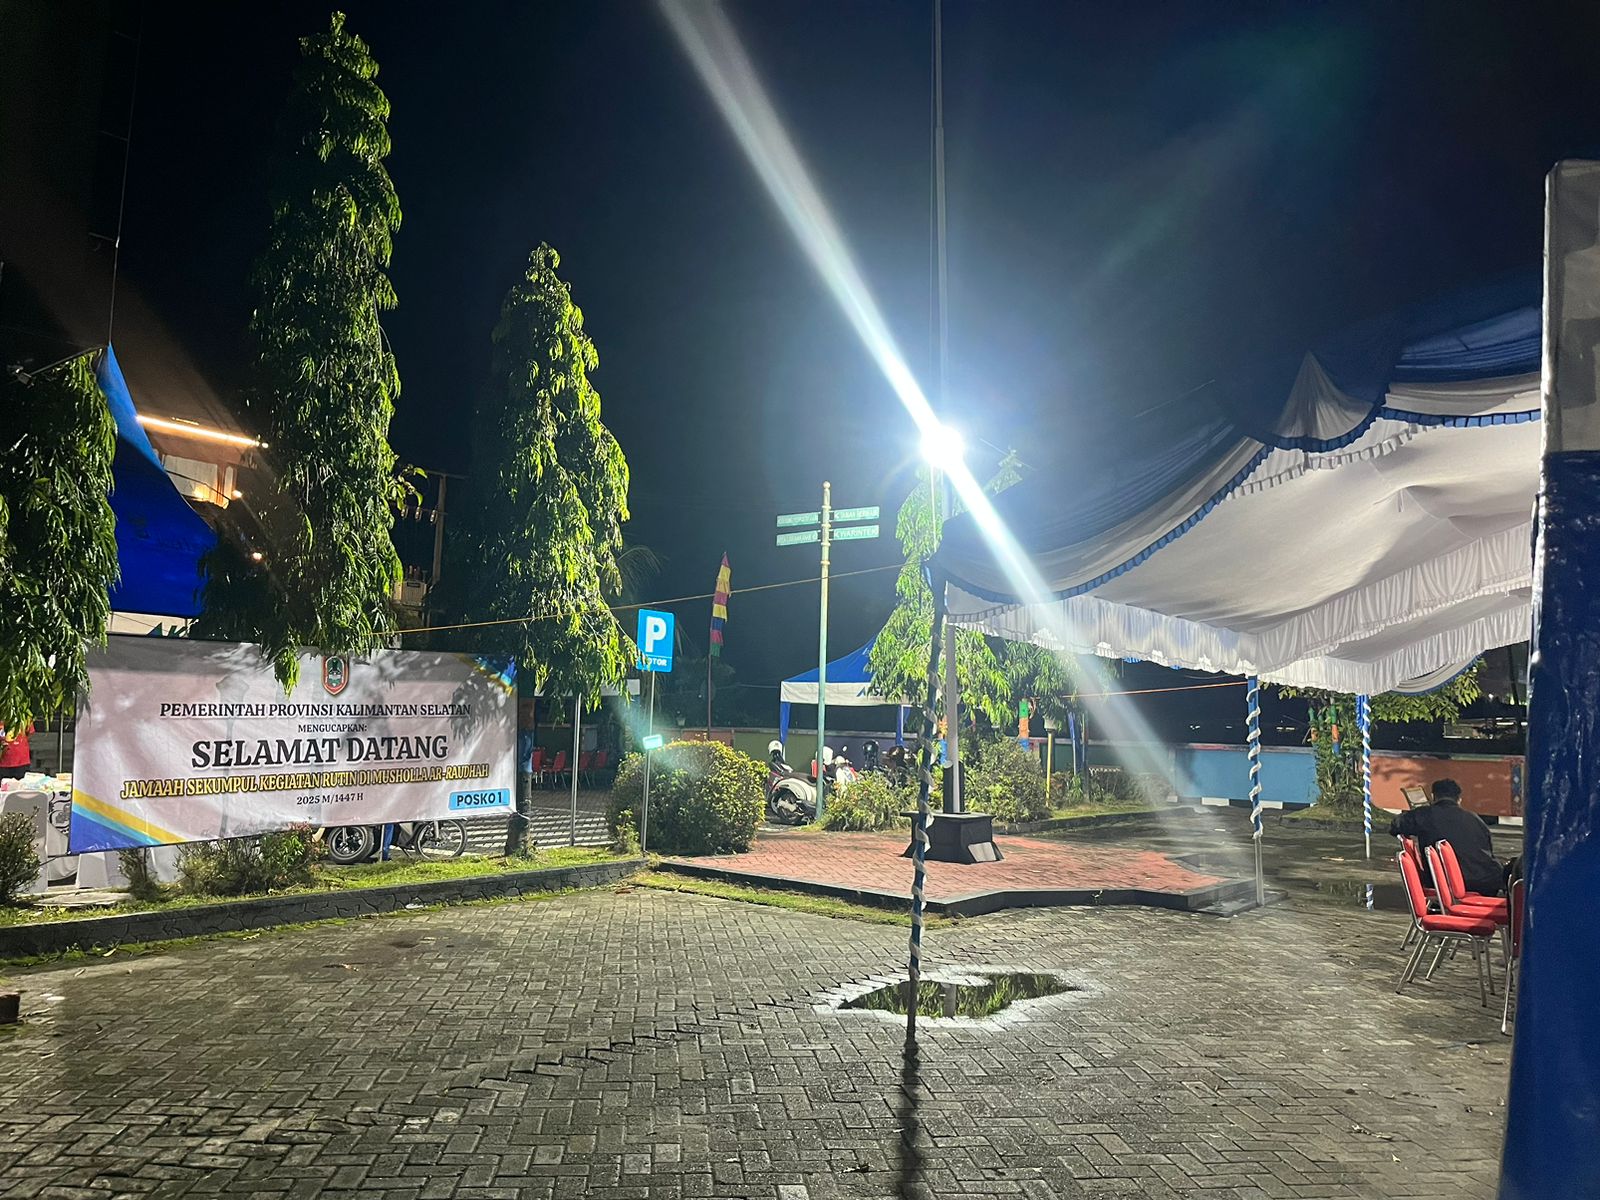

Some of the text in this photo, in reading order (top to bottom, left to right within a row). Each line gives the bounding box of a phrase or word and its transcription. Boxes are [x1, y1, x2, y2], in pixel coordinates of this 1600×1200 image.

[645, 615, 667, 653] P
[642, 656, 667, 666] OTOR
[160, 703, 471, 717] PEMERINTAH PROVINSI KALIMANTAN SELATAN
[298, 724, 367, 733] MENGUCAPKAN:
[191, 735, 448, 768] SELAMAT DATANG
[121, 763, 489, 799] JAMAAH SEKUMPUL KEGIATAN RUTIN DI MUSHOLLA AR-RAUDHAH
[296, 795, 320, 805] 2025
[356, 792, 364, 801] H
[457, 791, 502, 806] POSKO 1
